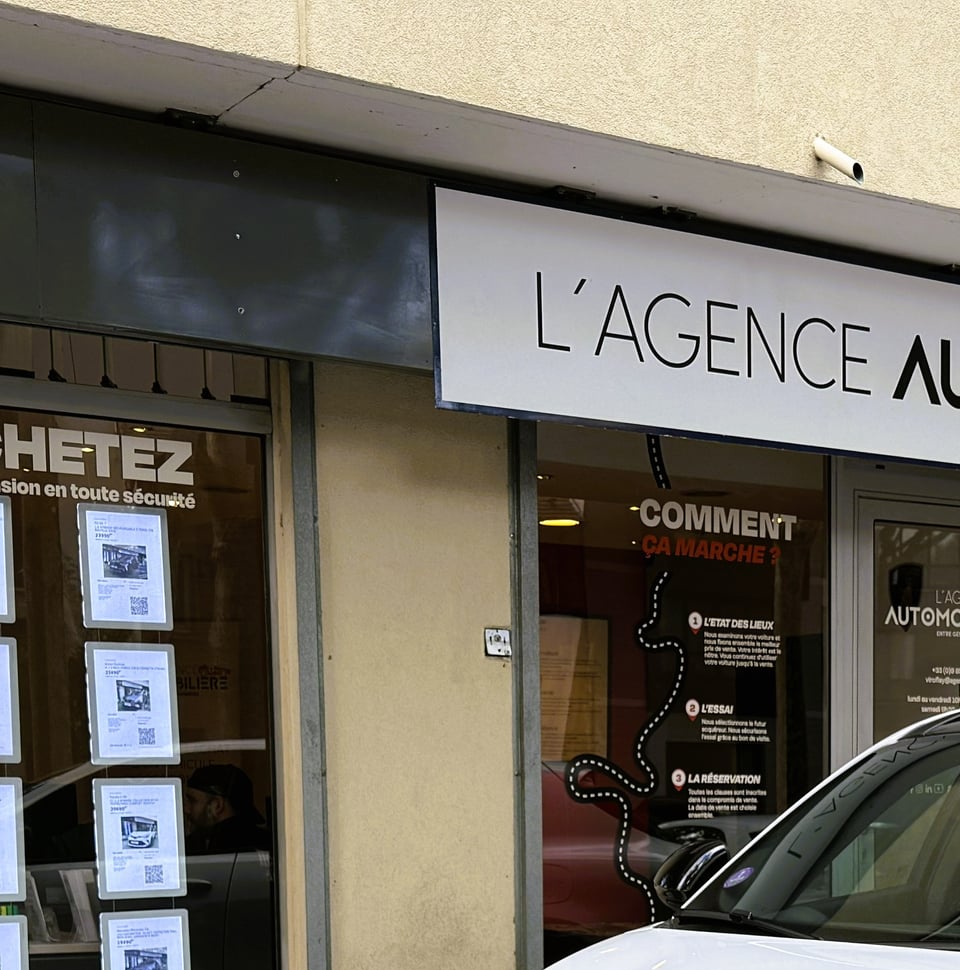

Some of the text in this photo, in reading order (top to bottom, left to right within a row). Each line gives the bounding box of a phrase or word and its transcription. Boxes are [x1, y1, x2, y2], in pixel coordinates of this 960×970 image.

[535, 271, 872, 396] L'AGENCE
[0, 422, 195, 486] HETEZ
[44, 484, 68, 498] en
[70, 483, 120, 503] toute
[122, 488, 197, 510] sécurité
[639, 498, 798, 541] COMMENT
[641, 534, 782, 565] ÇA MARCHE ?
[703, 617, 775, 631] L'ETAT DES LIEUX
[701, 703, 735, 715] L'ESSAI
[687, 771, 761, 785] LA RÉSERVATION
